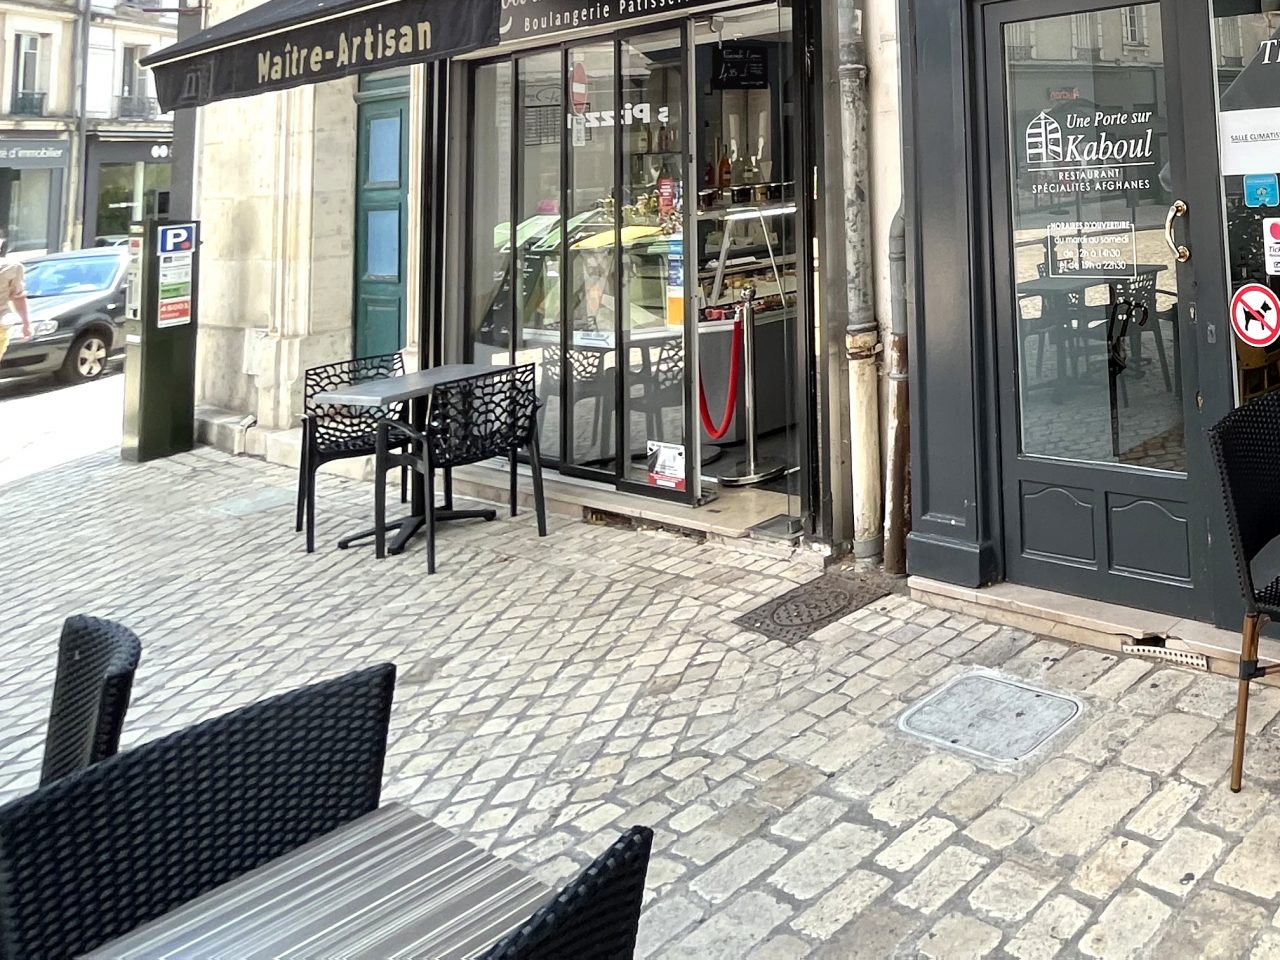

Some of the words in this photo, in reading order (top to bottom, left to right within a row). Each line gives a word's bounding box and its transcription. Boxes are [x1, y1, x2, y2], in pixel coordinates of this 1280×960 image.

[524, 3, 611, 32] Boulangerie
[258, 21, 432, 83] Maître-Artisan
[1066, 113, 1091, 129] Une
[1094, 112, 1127, 127] Porte
[1131, 111, 1152, 124] sur
[1230, 133, 1249, 142] SALLE
[1064, 129, 1152, 162] Kaboul
[1058, 169, 1120, 181] RESTAURANT
[1094, 179, 1150, 191] AFGHANES
[1050, 221, 1083, 230] HORAIRES
[1084, 220, 1131, 229] D'OUVERTURE
[166, 228, 188, 250] P
[1054, 236, 1065, 244] du
[1065, 235, 1088, 244] mardi
[1088, 236, 1099, 244] au
[1099, 234, 1129, 244] samedi
[1063, 249, 1073, 257] de
[1098, 248, 1120, 258] 14h30
